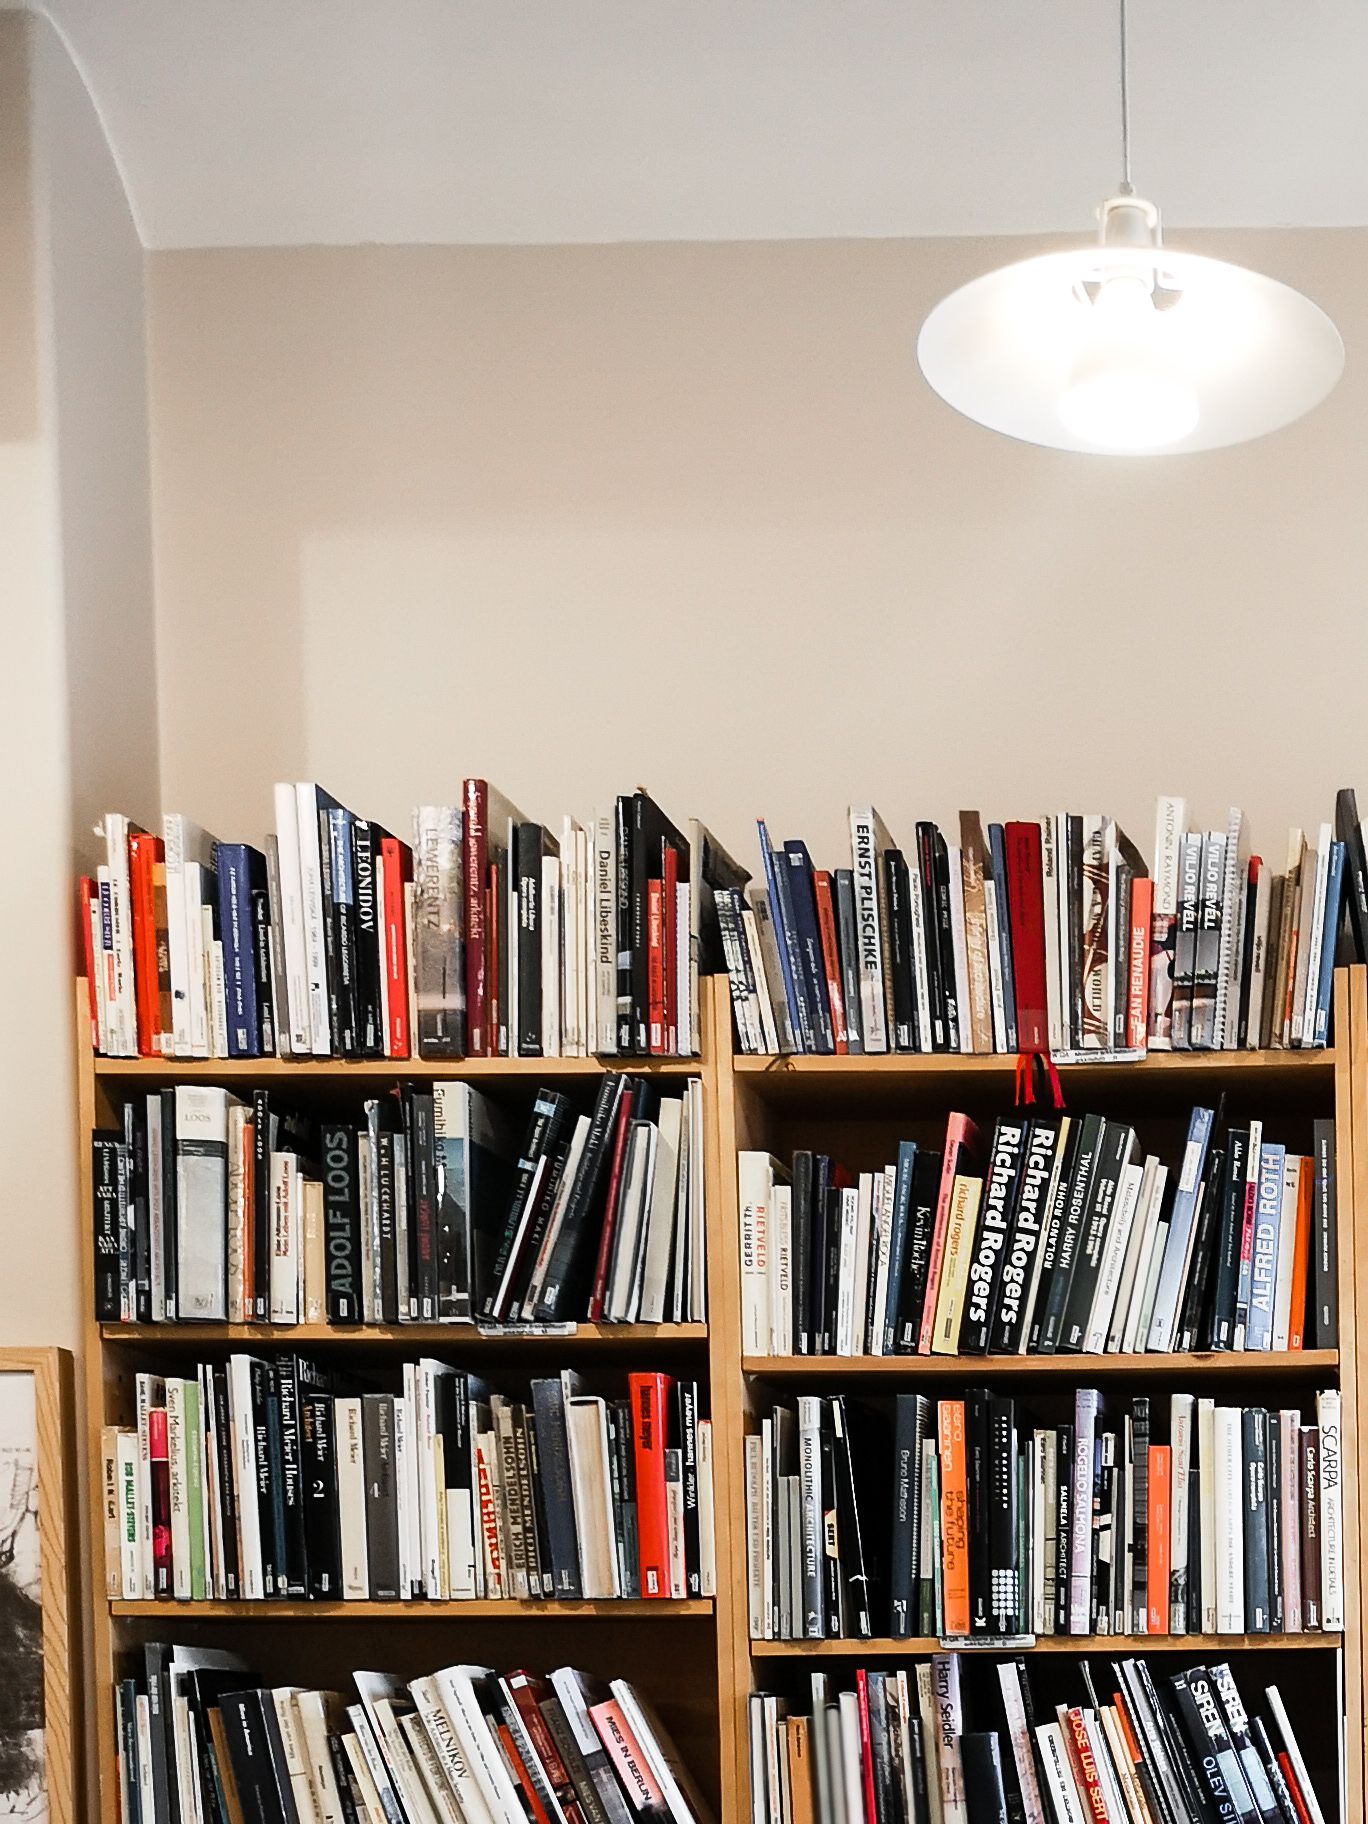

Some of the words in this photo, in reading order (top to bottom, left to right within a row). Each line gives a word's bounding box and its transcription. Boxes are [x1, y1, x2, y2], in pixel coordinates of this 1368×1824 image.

[1164, 802, 1175, 850] ANTONIN
[599, 850, 611, 894] Daniel
[856, 824, 874, 881] ERNST
[1183, 847, 1197, 882] VILJO
[1205, 845, 1219, 881] VILJO
[356, 840, 374, 932] LEONIDOV
[425, 828, 440, 929] LEWERENTZ
[1162, 855, 1174, 910] RAYMOND
[600, 898, 612, 964] Libeskind
[860, 885, 878, 970] PLISCHKE
[1180, 885, 1196, 932] REVELL
[1202, 884, 1218, 930] REVELL
[1132, 927, 1144, 996] RENAUDIE
[1092, 969, 1104, 1012] WORLD
[325, 1131, 350, 1202] LOOS
[983, 1126, 1022, 1227] Richard
[1016, 1128, 1057, 1229] Richard
[1260, 1154, 1280, 1216] ROTH
[956, 1183, 968, 1220] richard
[1044, 1220, 1060, 1269] ROLAND
[1054, 1182, 1067, 1216] ROHN
[1060, 1226, 1074, 1269] HARRY
[1068, 1151, 1092, 1224] ROSENTHAL
[328, 1210, 354, 1294] ADOLF
[756, 1206, 766, 1268] RIETVELD
[950, 1222, 962, 1256] rogers
[780, 1247, 789, 1291] RIETVELD
[968, 1231, 1003, 1323] Rogers
[1000, 1232, 1036, 1324] Rogers
[1252, 1224, 1274, 1313] ALFRED
[166, 1388, 179, 1413] Sven
[280, 1379, 295, 1424] Richard
[347, 1408, 358, 1440] Richard
[640, 1385, 653, 1420] hannes
[952, 1404, 963, 1441] eero
[168, 1415, 181, 1470] Markelius,
[282, 1428, 296, 1462] Meier
[348, 1442, 358, 1464] Meier
[640, 1422, 652, 1450] meyer
[942, 1404, 954, 1472] saarinen
[1307, 1446, 1316, 1469] Carlo
[1322, 1425, 1338, 1490] SCARPA
[284, 1464, 298, 1506] Houses
[502, 1436, 522, 1526] MENDELSOHN
[804, 1437, 814, 1501] MONOLITHIC
[900, 1450, 910, 1476] Bruno
[1306, 1470, 1316, 1498] Scarpa
[171, 1472, 183, 1512] arkitekt
[946, 1491, 956, 1518] the
[1060, 1485, 1068, 1525] SALMELA
[806, 1503, 816, 1578] ARCHITECTURE
[954, 1490, 966, 1550] shaping
[1074, 1494, 1088, 1553] SALMONA
[1308, 1500, 1316, 1538] Architect
[513, 1532, 526, 1569] ERICH
[946, 1521, 958, 1570] future
[1059, 1532, 1068, 1579] ARCHITECT
[936, 1660, 952, 1700] Harry
[430, 1708, 470, 1780] MELNIKOV
[940, 1702, 956, 1750] Seidler
[605, 1716, 625, 1744] MIES
[620, 1746, 632, 1759] IN
[626, 1760, 653, 1801] BERLIN
[1070, 1712, 1092, 1750] JOSE
[1082, 1751, 1098, 1783] LUIS
[1090, 1786, 1108, 1822] SERT
[1202, 1756, 1226, 1798] OLEV
